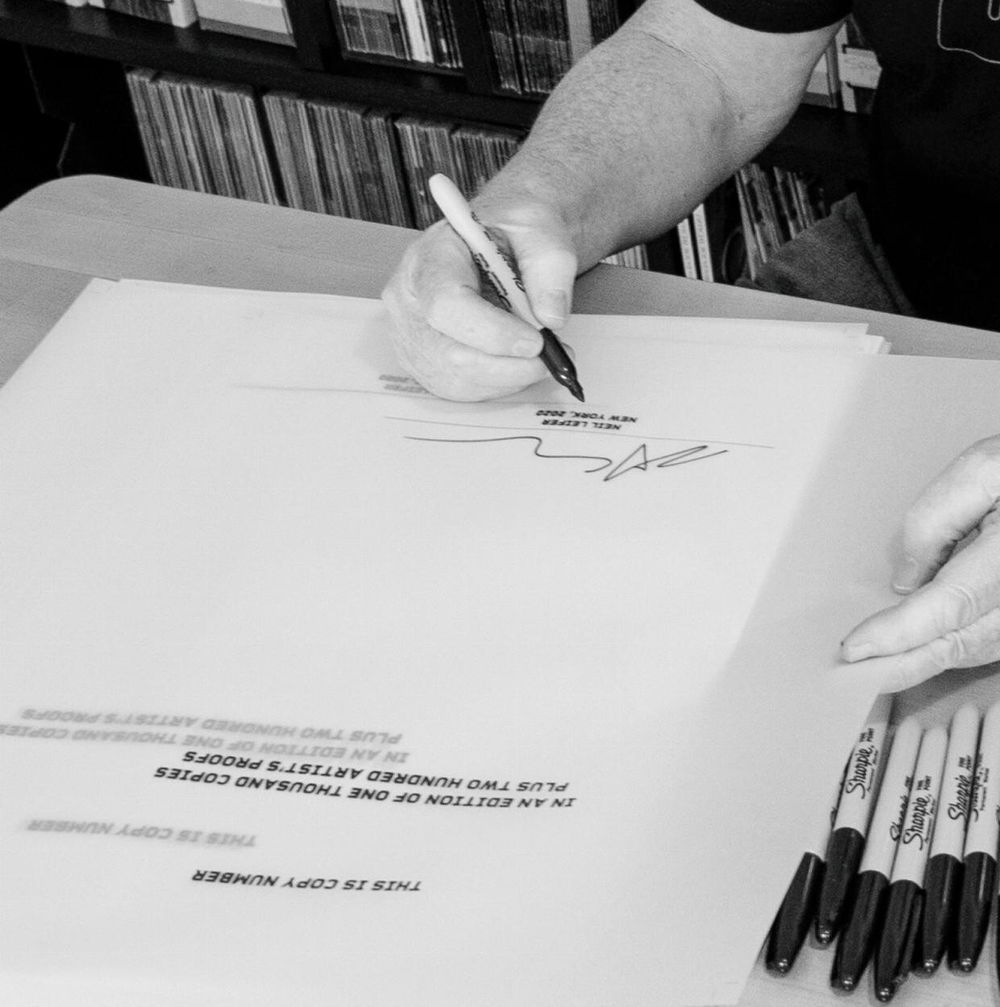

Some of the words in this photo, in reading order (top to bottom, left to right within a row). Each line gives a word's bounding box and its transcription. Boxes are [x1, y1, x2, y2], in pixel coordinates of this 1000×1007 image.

[535, 409, 567, 418] 2020
[571, 411, 605, 421] YORK,
[608, 414, 638, 423] NEW
[542, 419, 588, 428] LEIFER
[591, 421, 622, 430] NEIL
[21, 708, 101, 724] PROOFS
[103, 712, 199, 729] ARTIST'S
[201, 717, 297, 737] HUNDRED
[300, 725, 344, 741] TWO
[71, 728, 177, 745] THOUSAND
[181, 734, 224, 748] ONE
[348, 729, 403, 745] PLUS
[226, 739, 253, 753] OF
[258, 742, 347, 759] EDITION
[182, 750, 264, 770] PROOFS
[350, 748, 379, 762] AN
[384, 750, 411, 765] IN
[153, 766, 232, 786] COPIES
[266, 759, 365, 780] ARTIST'S
[846, 744, 875, 800] Sharpie
[234, 775, 343, 798] THOUSAND
[366, 769, 464, 789] HUNDRED
[466, 778, 512, 792] TWO
[515, 780, 570, 793] PLUS
[346, 786, 391, 802] ONE
[392, 791, 422, 805] OF
[424, 793, 515, 809] EDITION
[947, 774, 973, 821] Sharpie
[517, 797, 548, 809] AN
[550, 797, 578, 808] IN
[26, 818, 115, 836] NUMBER
[902, 793, 932, 852] Sharpie
[117, 822, 173, 840] COPY
[178, 828, 206, 843] IS
[207, 832, 257, 848] THIS
[192, 868, 280, 887] NUMBER
[281, 875, 339, 890] COPY
[342, 878, 368, 891] IS
[371, 879, 422, 892] THIS
